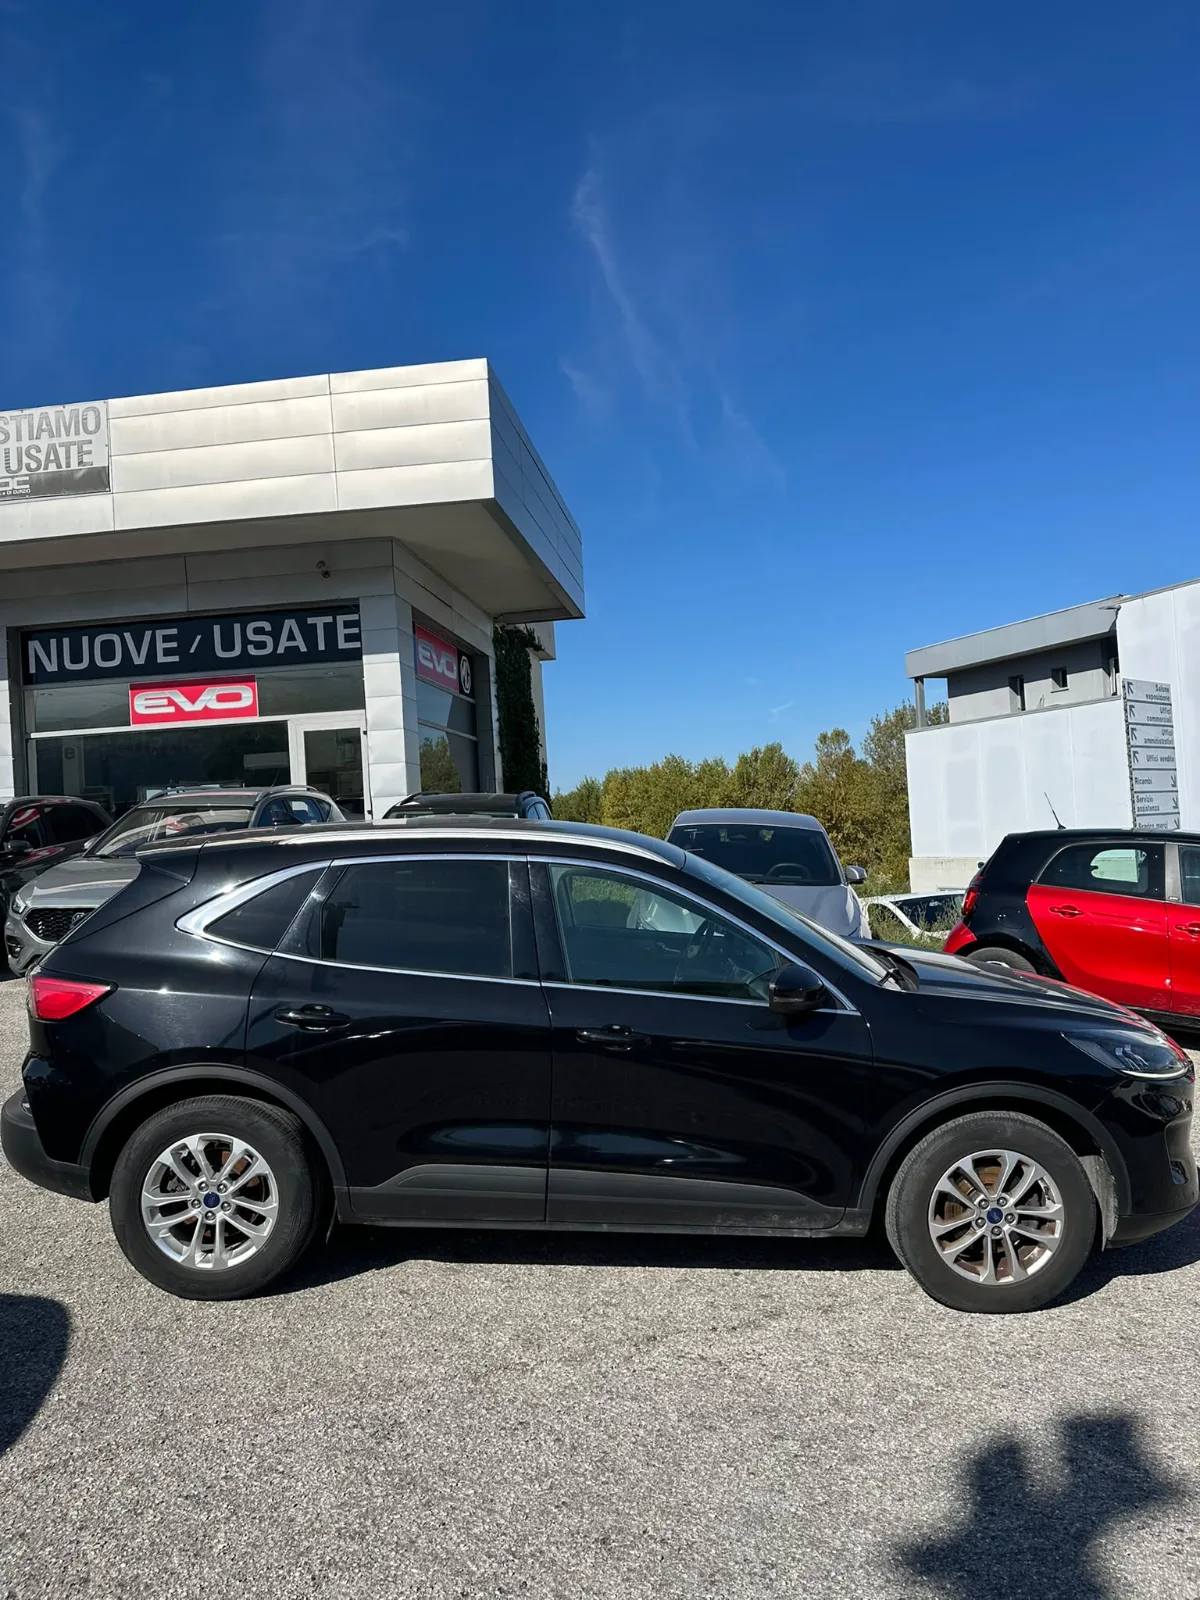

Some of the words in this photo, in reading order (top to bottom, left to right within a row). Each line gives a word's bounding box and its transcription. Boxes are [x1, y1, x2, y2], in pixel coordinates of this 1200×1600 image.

[4, 439, 93, 475] USATE
[28, 628, 180, 674] NUOVE
[213, 613, 362, 658] USATE
[418, 639, 457, 680] EVO
[1155, 684, 1170, 693] Salone
[133, 685, 253, 714] EVO
[1134, 776, 1153, 785] Ricambi
[1136, 794, 1154, 804] Servizio
[1137, 804, 1160, 813] assistenza
